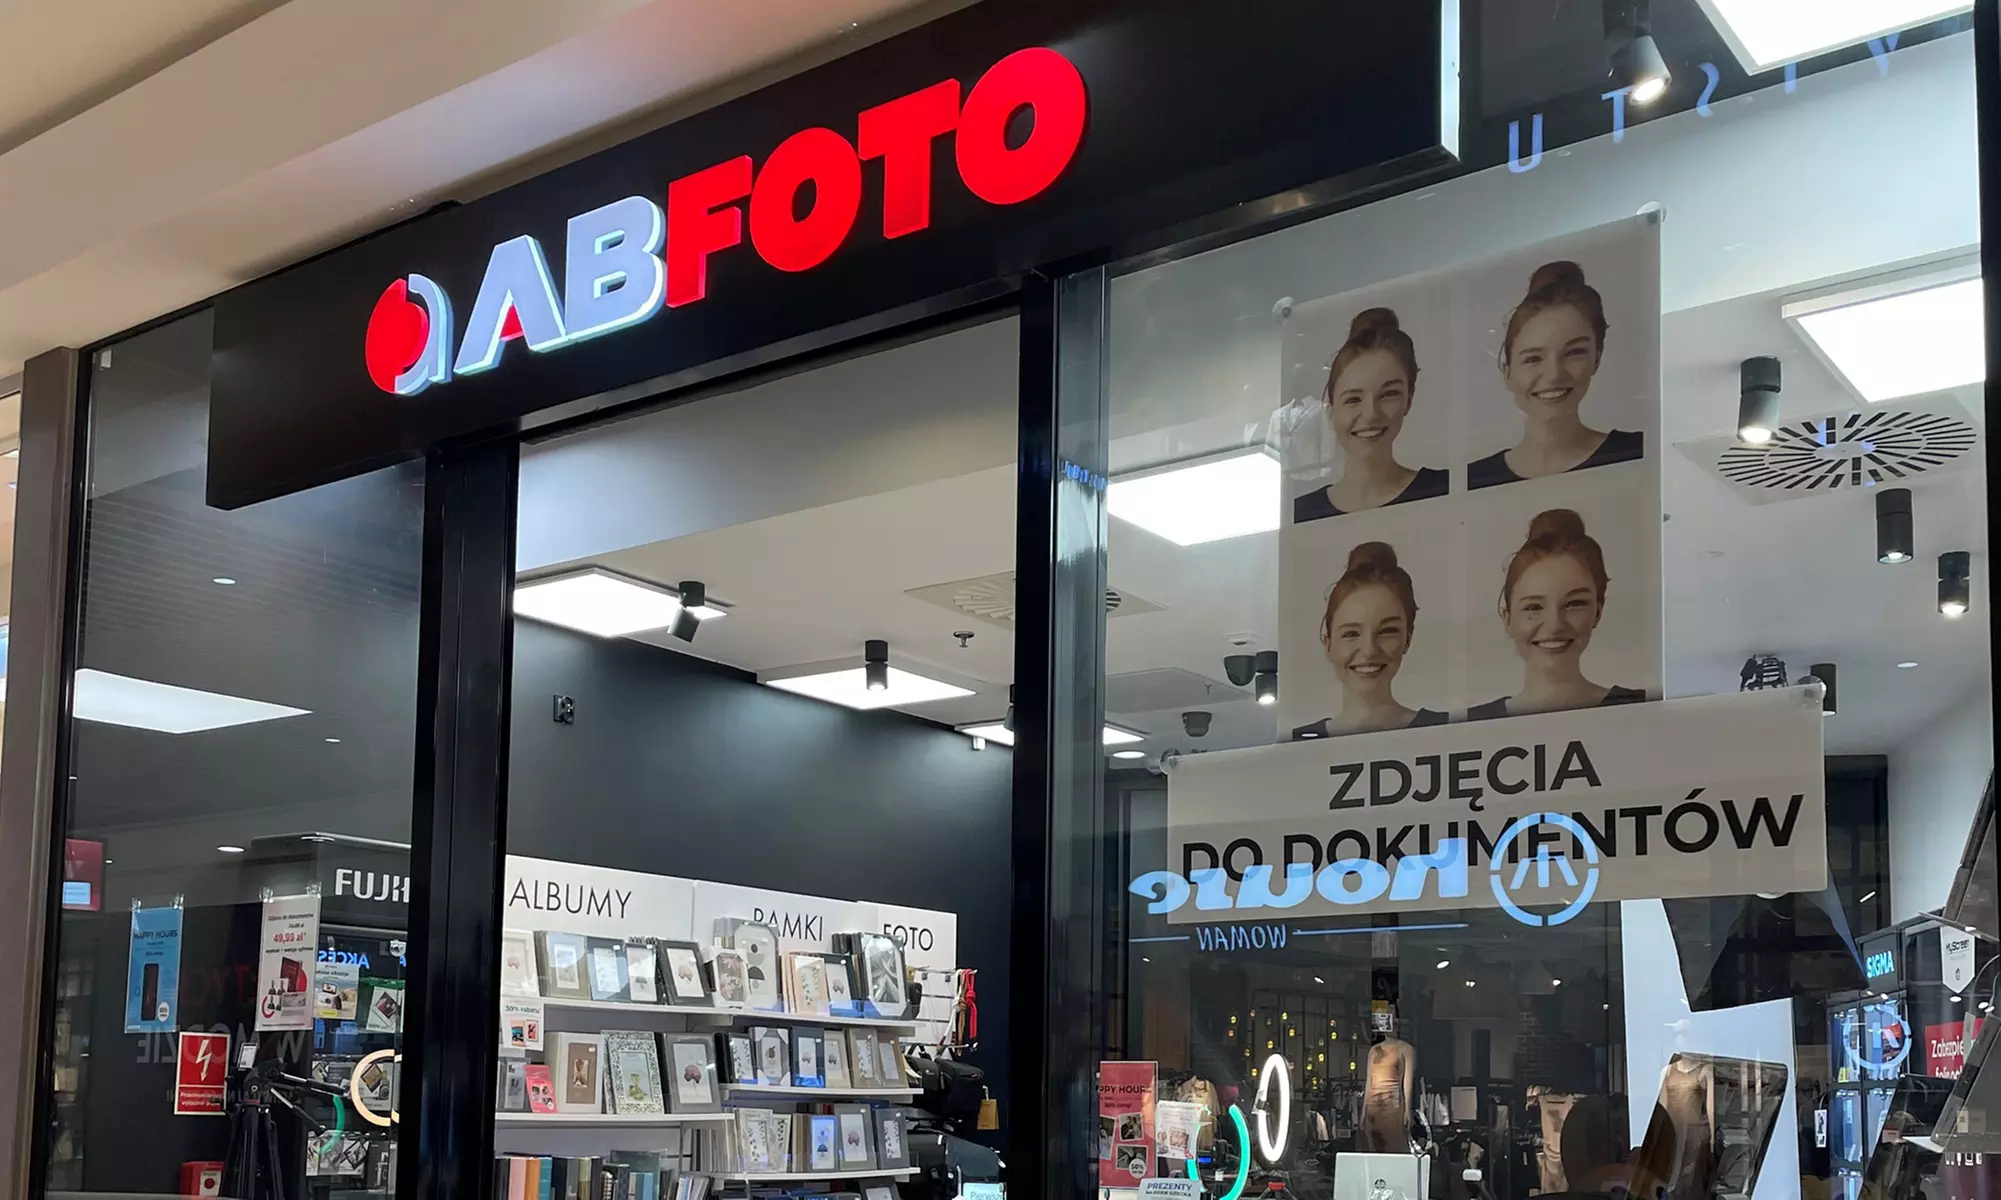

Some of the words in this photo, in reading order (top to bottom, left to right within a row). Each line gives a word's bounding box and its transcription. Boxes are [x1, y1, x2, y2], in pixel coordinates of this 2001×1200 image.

[454, 46, 1087, 374] ABFOTO
[1329, 740, 1602, 812] ZDJĘCIA
[1183, 838, 1263, 885] DO
[1284, 788, 1805, 879] DOKUMENTÓW
[508, 878, 632, 919] ALBUMY
[1866, 951, 1895, 978] SIGMA
[1931, 1034, 1966, 1060] Zabezpie
[1147, 1183, 1193, 1192] PREZENTY
